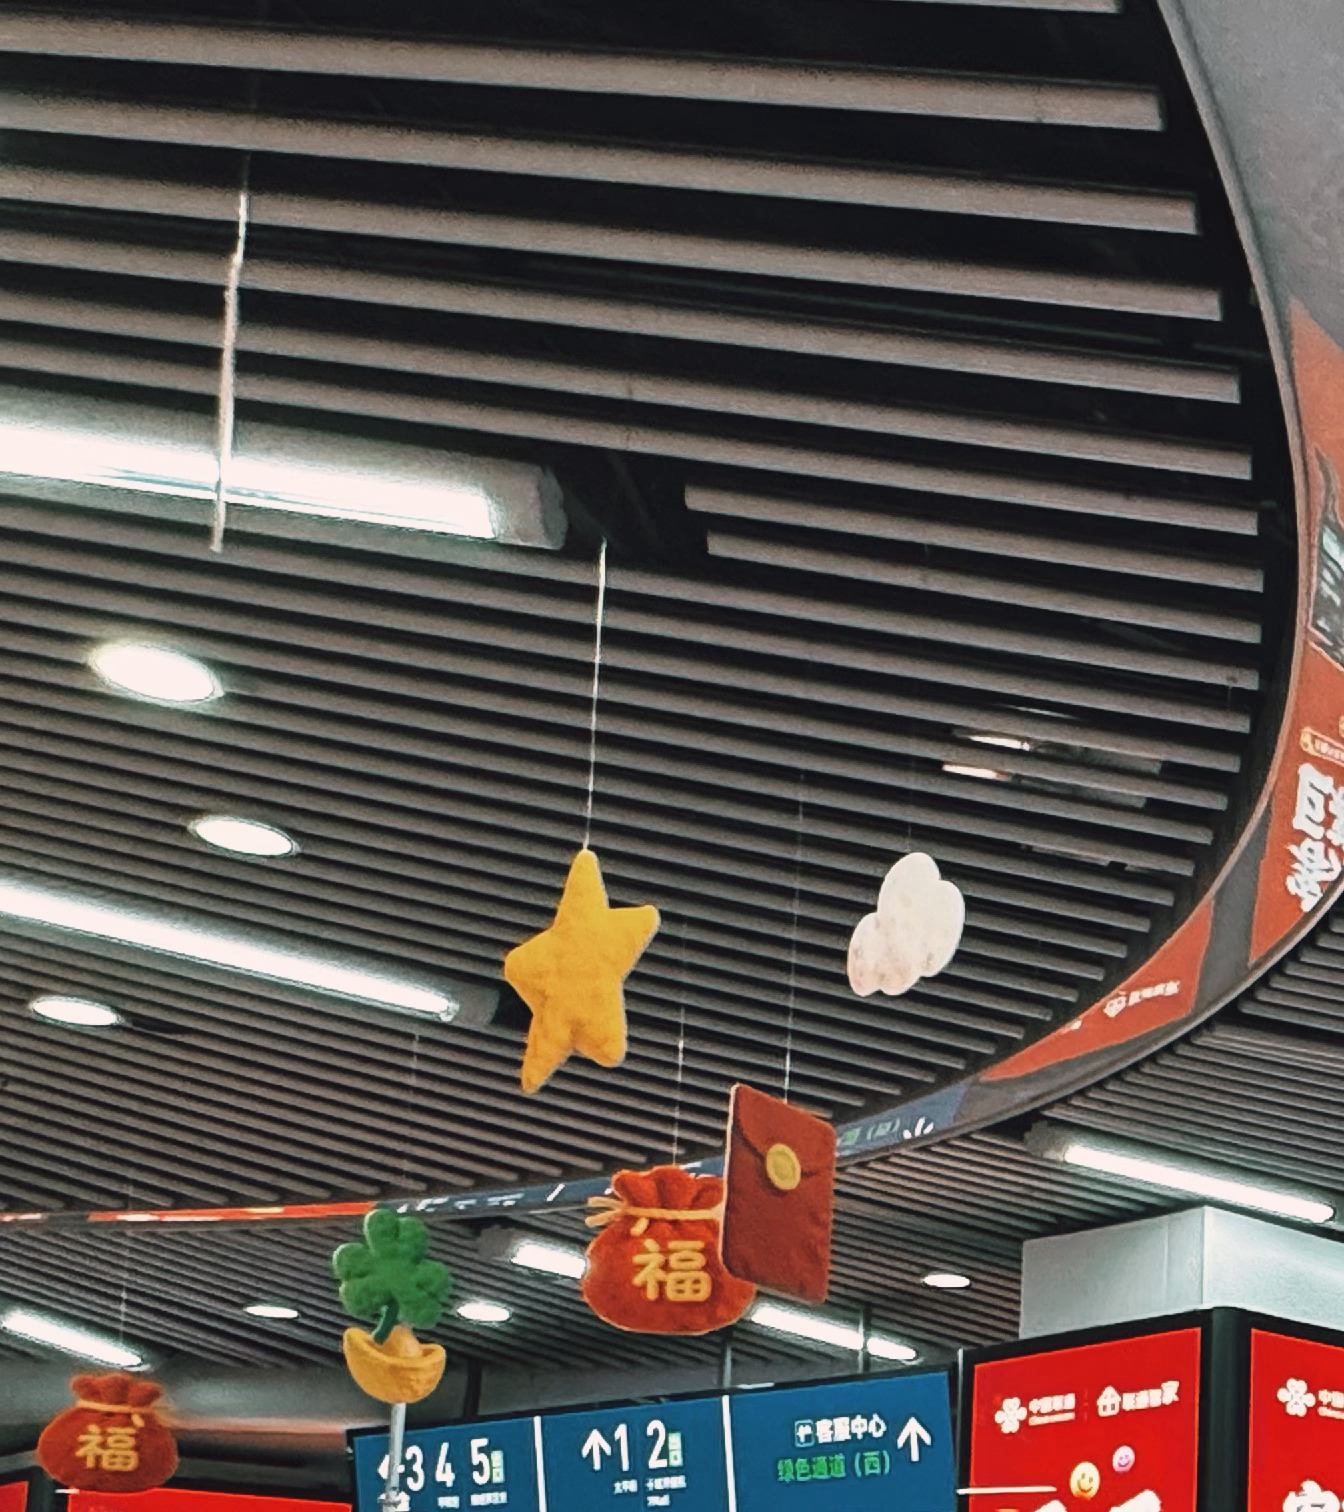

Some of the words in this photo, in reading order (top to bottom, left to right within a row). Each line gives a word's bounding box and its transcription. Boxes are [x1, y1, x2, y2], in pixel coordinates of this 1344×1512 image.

[631, 1239, 712, 1303] 福
[75, 1424, 139, 1472] 福
[613, 1422, 630, 1472] 1
[645, 1419, 668, 1470] 2
[816, 1413, 887, 1444] 客服中心
[404, 1445, 426, 1492] 3
[434, 1441, 456, 1488] 4
[469, 1437, 491, 1486] 5
